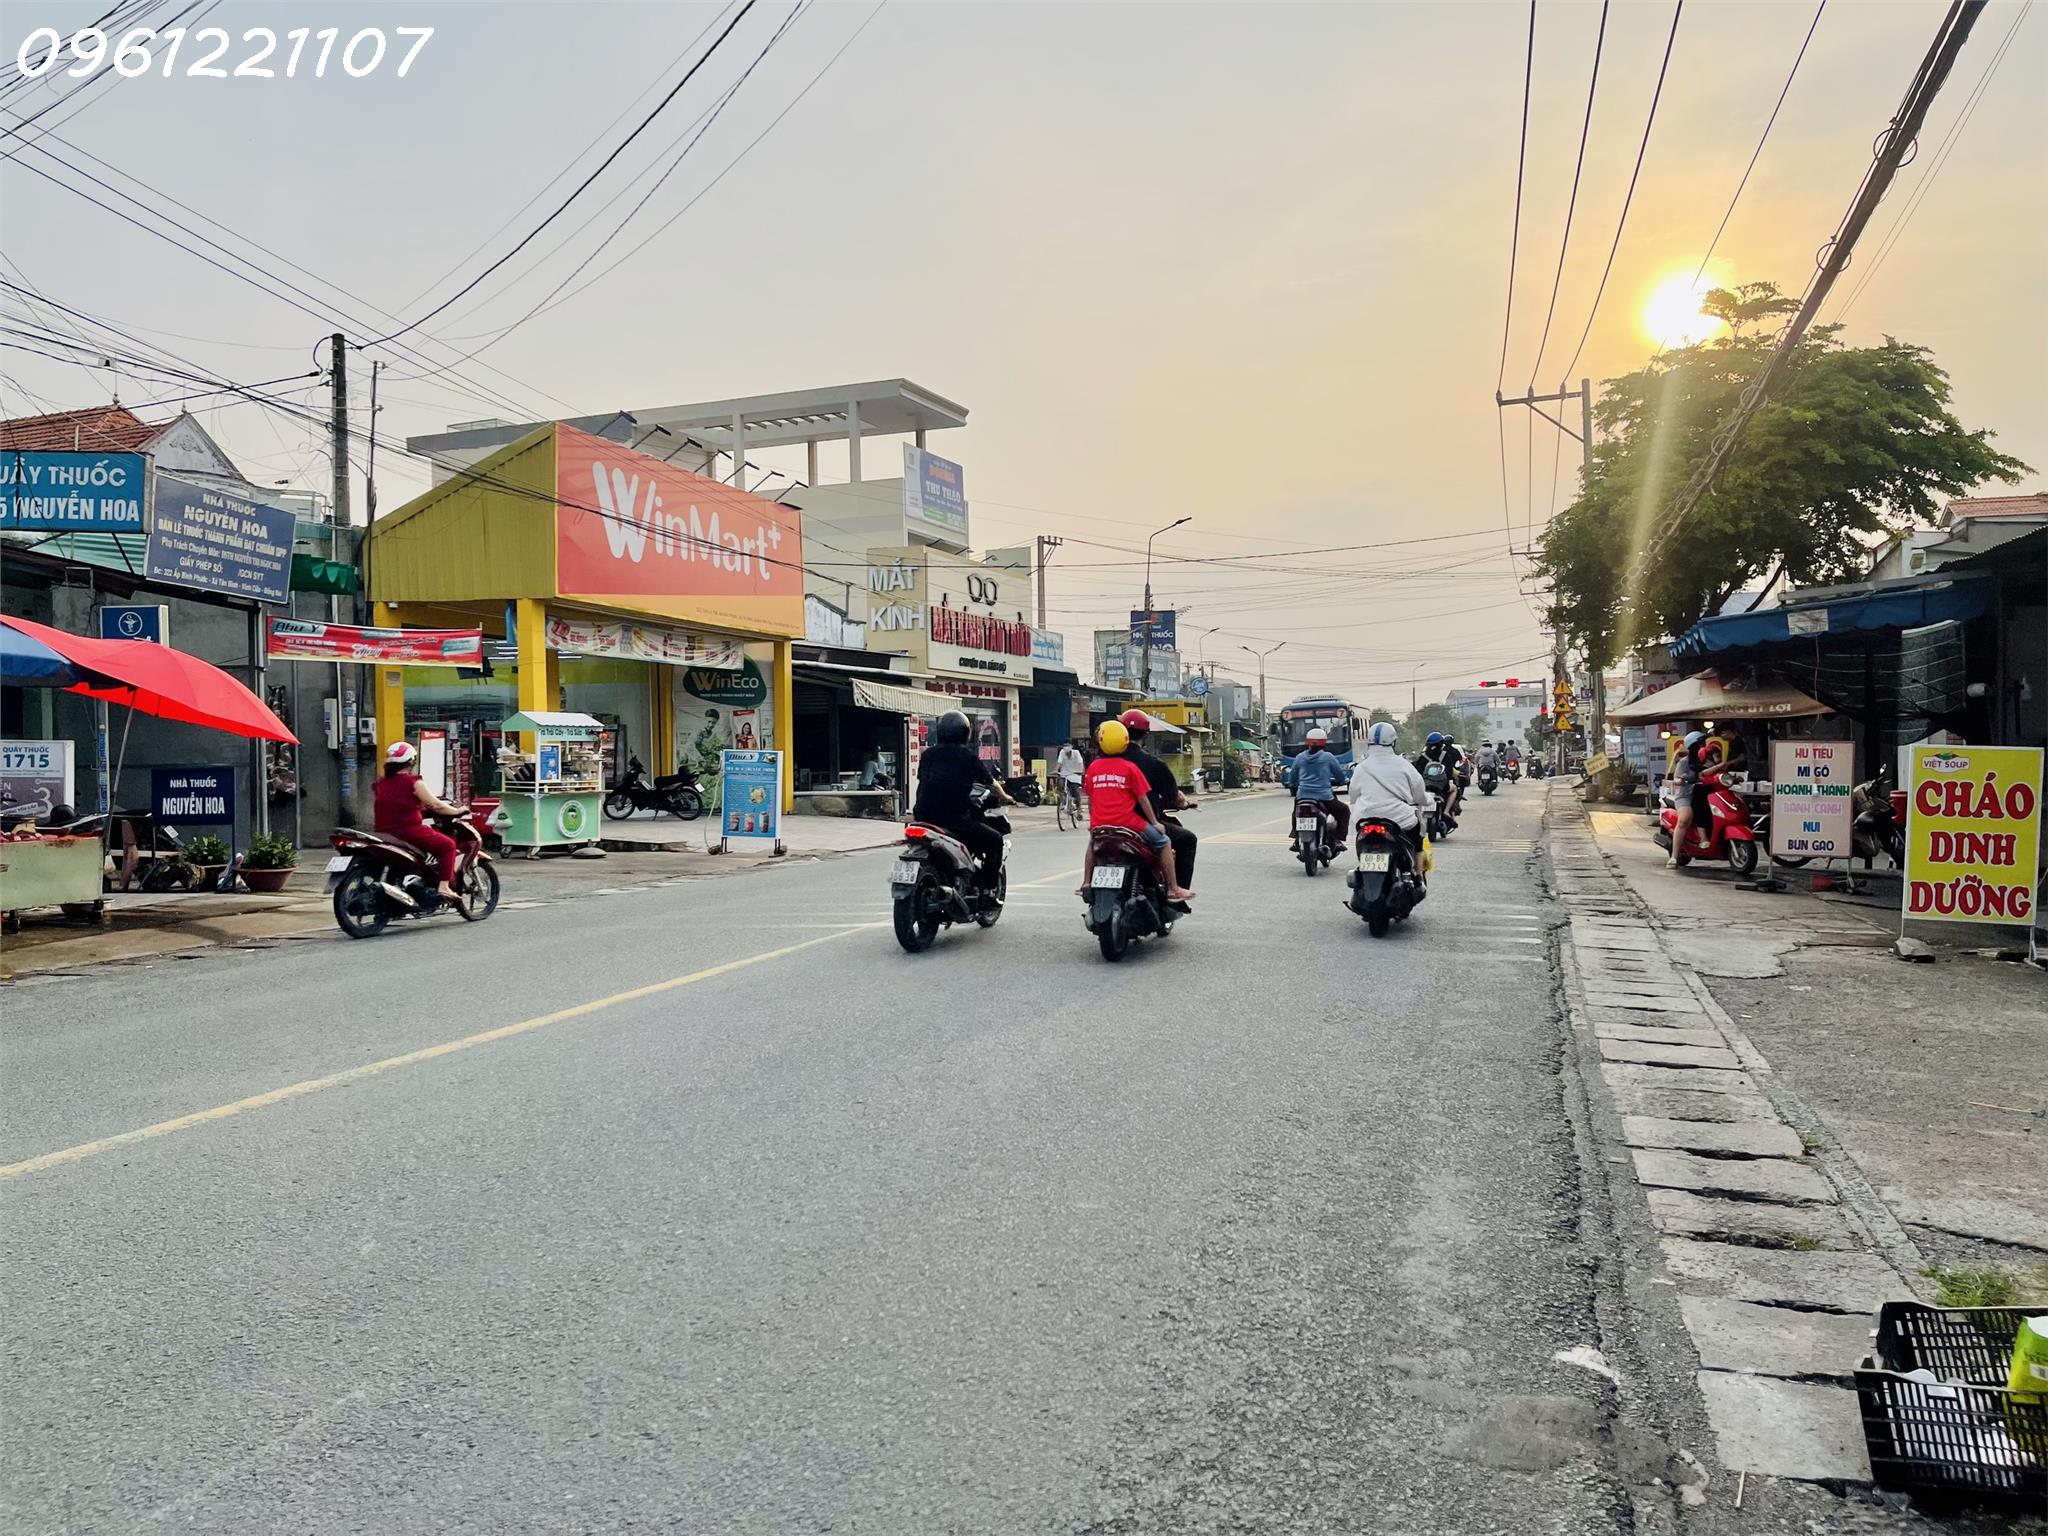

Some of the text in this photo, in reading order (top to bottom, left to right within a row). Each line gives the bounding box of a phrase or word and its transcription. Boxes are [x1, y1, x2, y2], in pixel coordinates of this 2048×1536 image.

[48, 460, 127, 487] THUỐC
[13, 490, 95, 520] NGUYỄN
[100, 499, 140, 522] HOA
[242, 519, 268, 539] HOA
[3, 753, 50, 768] 1715
[1923, 759, 1969, 769] VIỆT SOUP
[189, 775, 217, 788] THUỐC
[162, 791, 226, 815] NGUYỄN HOA
[1915, 771, 2036, 821] CHÁO
[1802, 821, 1821, 833] NUI
[1927, 831, 2017, 867] DINH
[1908, 874, 2032, 918] DƯỠNG
